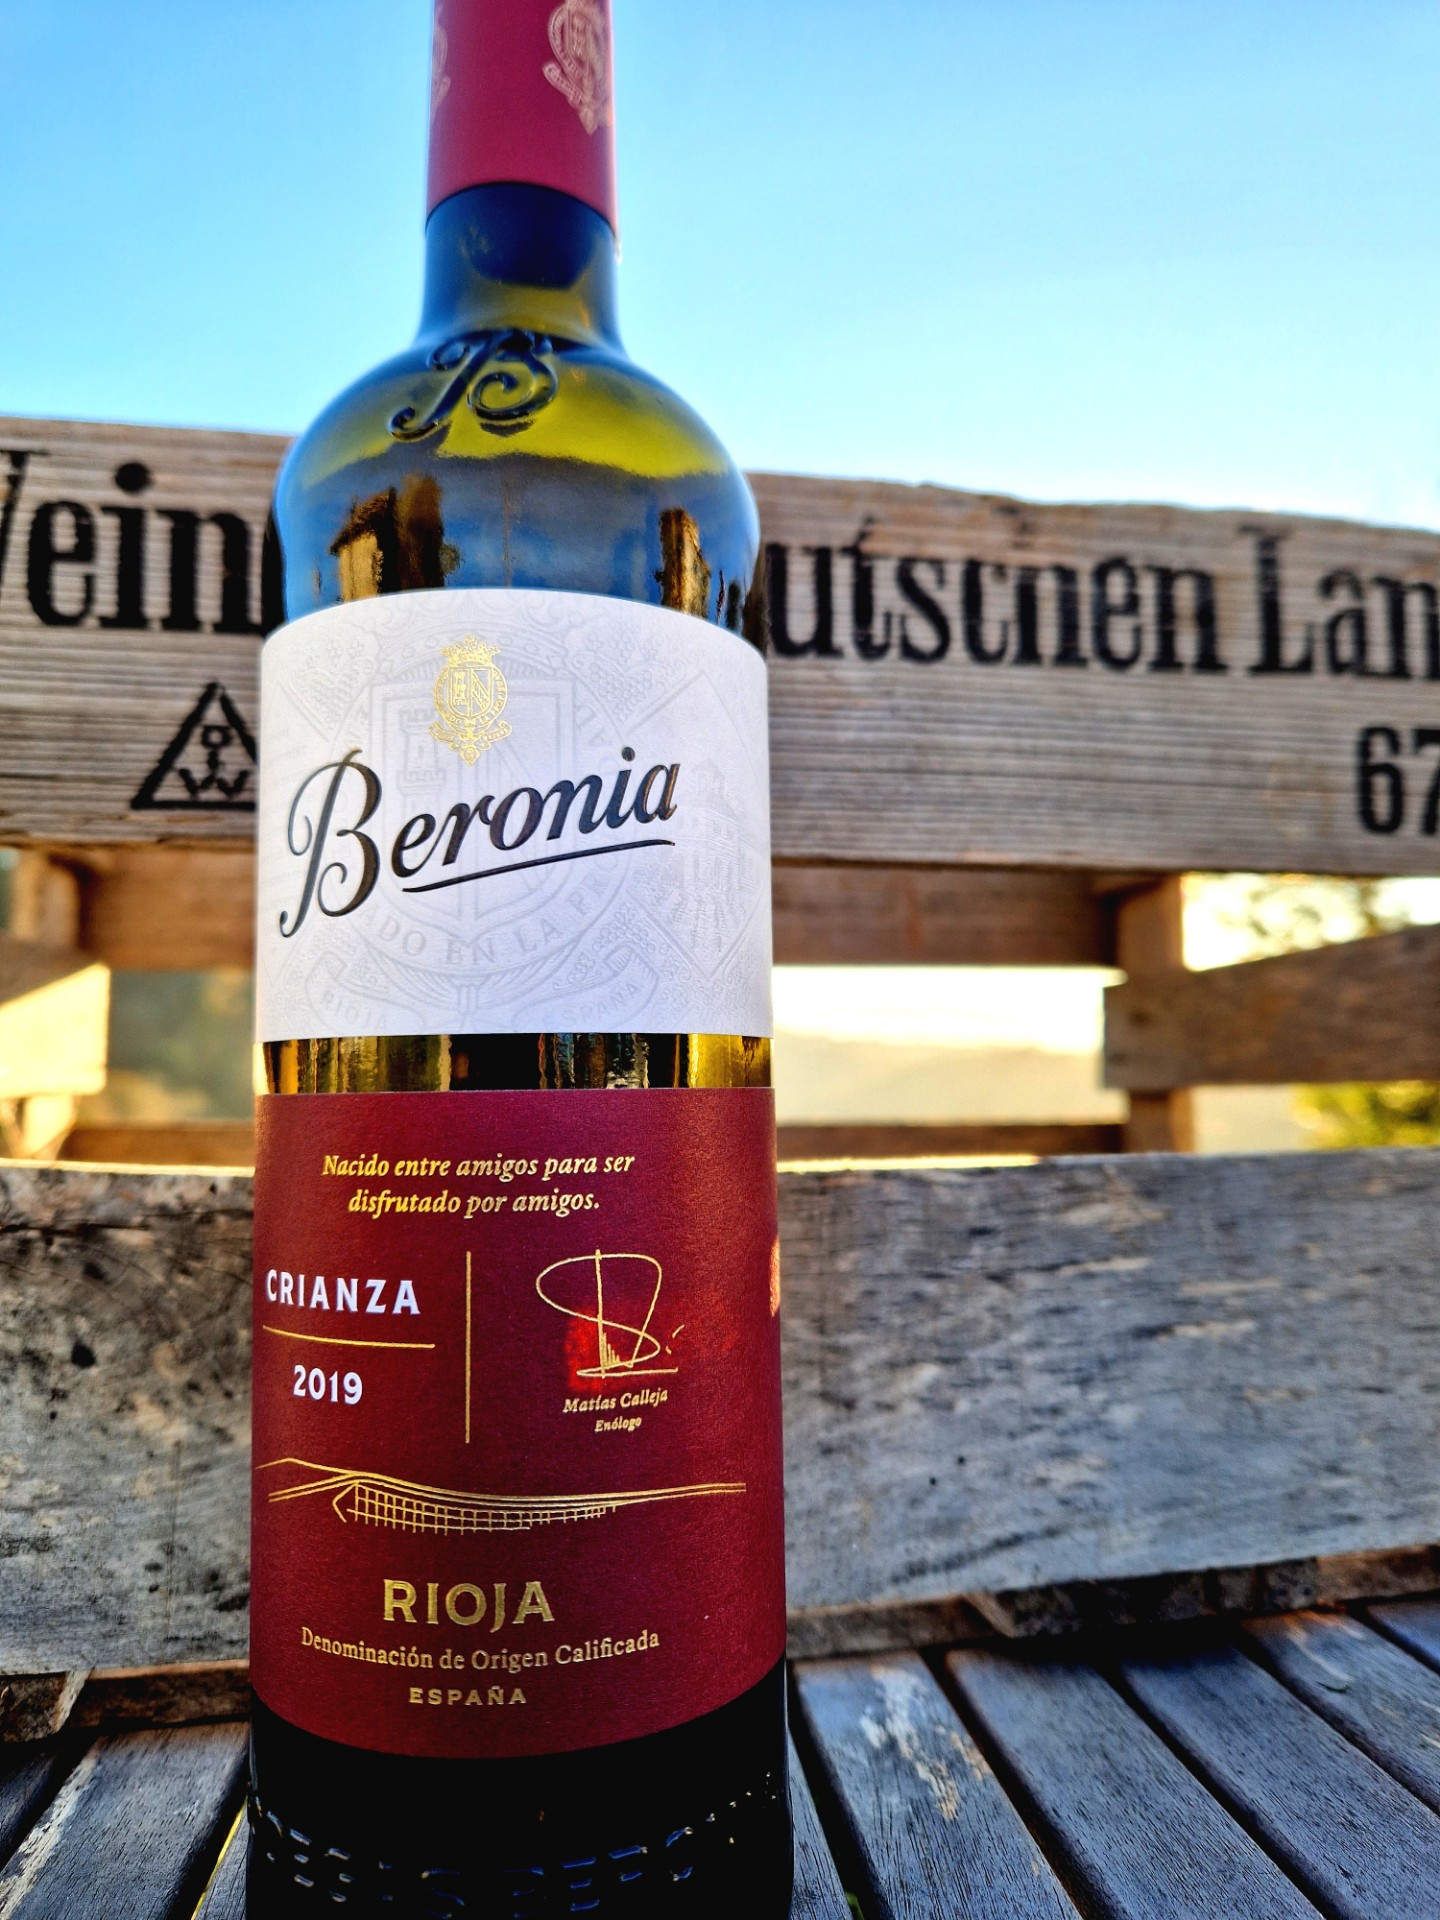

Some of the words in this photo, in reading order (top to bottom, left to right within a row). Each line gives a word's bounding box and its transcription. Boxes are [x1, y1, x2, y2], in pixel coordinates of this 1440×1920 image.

[279, 746, 681, 938] Beronia
[322, 1153, 390, 1178] Nacido
[394, 1155, 451, 1178] entre
[456, 1153, 539, 1183] amigos
[543, 1155, 598, 1181] para
[603, 1153, 635, 1174] ser
[348, 1189, 461, 1219] disfrutado
[464, 1194, 507, 1219] por
[512, 1188, 601, 1218] amigos.
[265, 1268, 421, 1316] CRIANZA
[293, 1364, 364, 1406] 2019
[562, 1394, 617, 1413] Matías
[620, 1387, 669, 1408] Calleja
[594, 1415, 642, 1433] Enólogo
[382, 1578, 555, 1634] RIOJA
[300, 1627, 433, 1670] Denominación
[439, 1648, 465, 1670] de
[471, 1648, 549, 1674] Origen
[554, 1629, 661, 1666] Calificada
[409, 1685, 527, 1707] ESPAÑA
